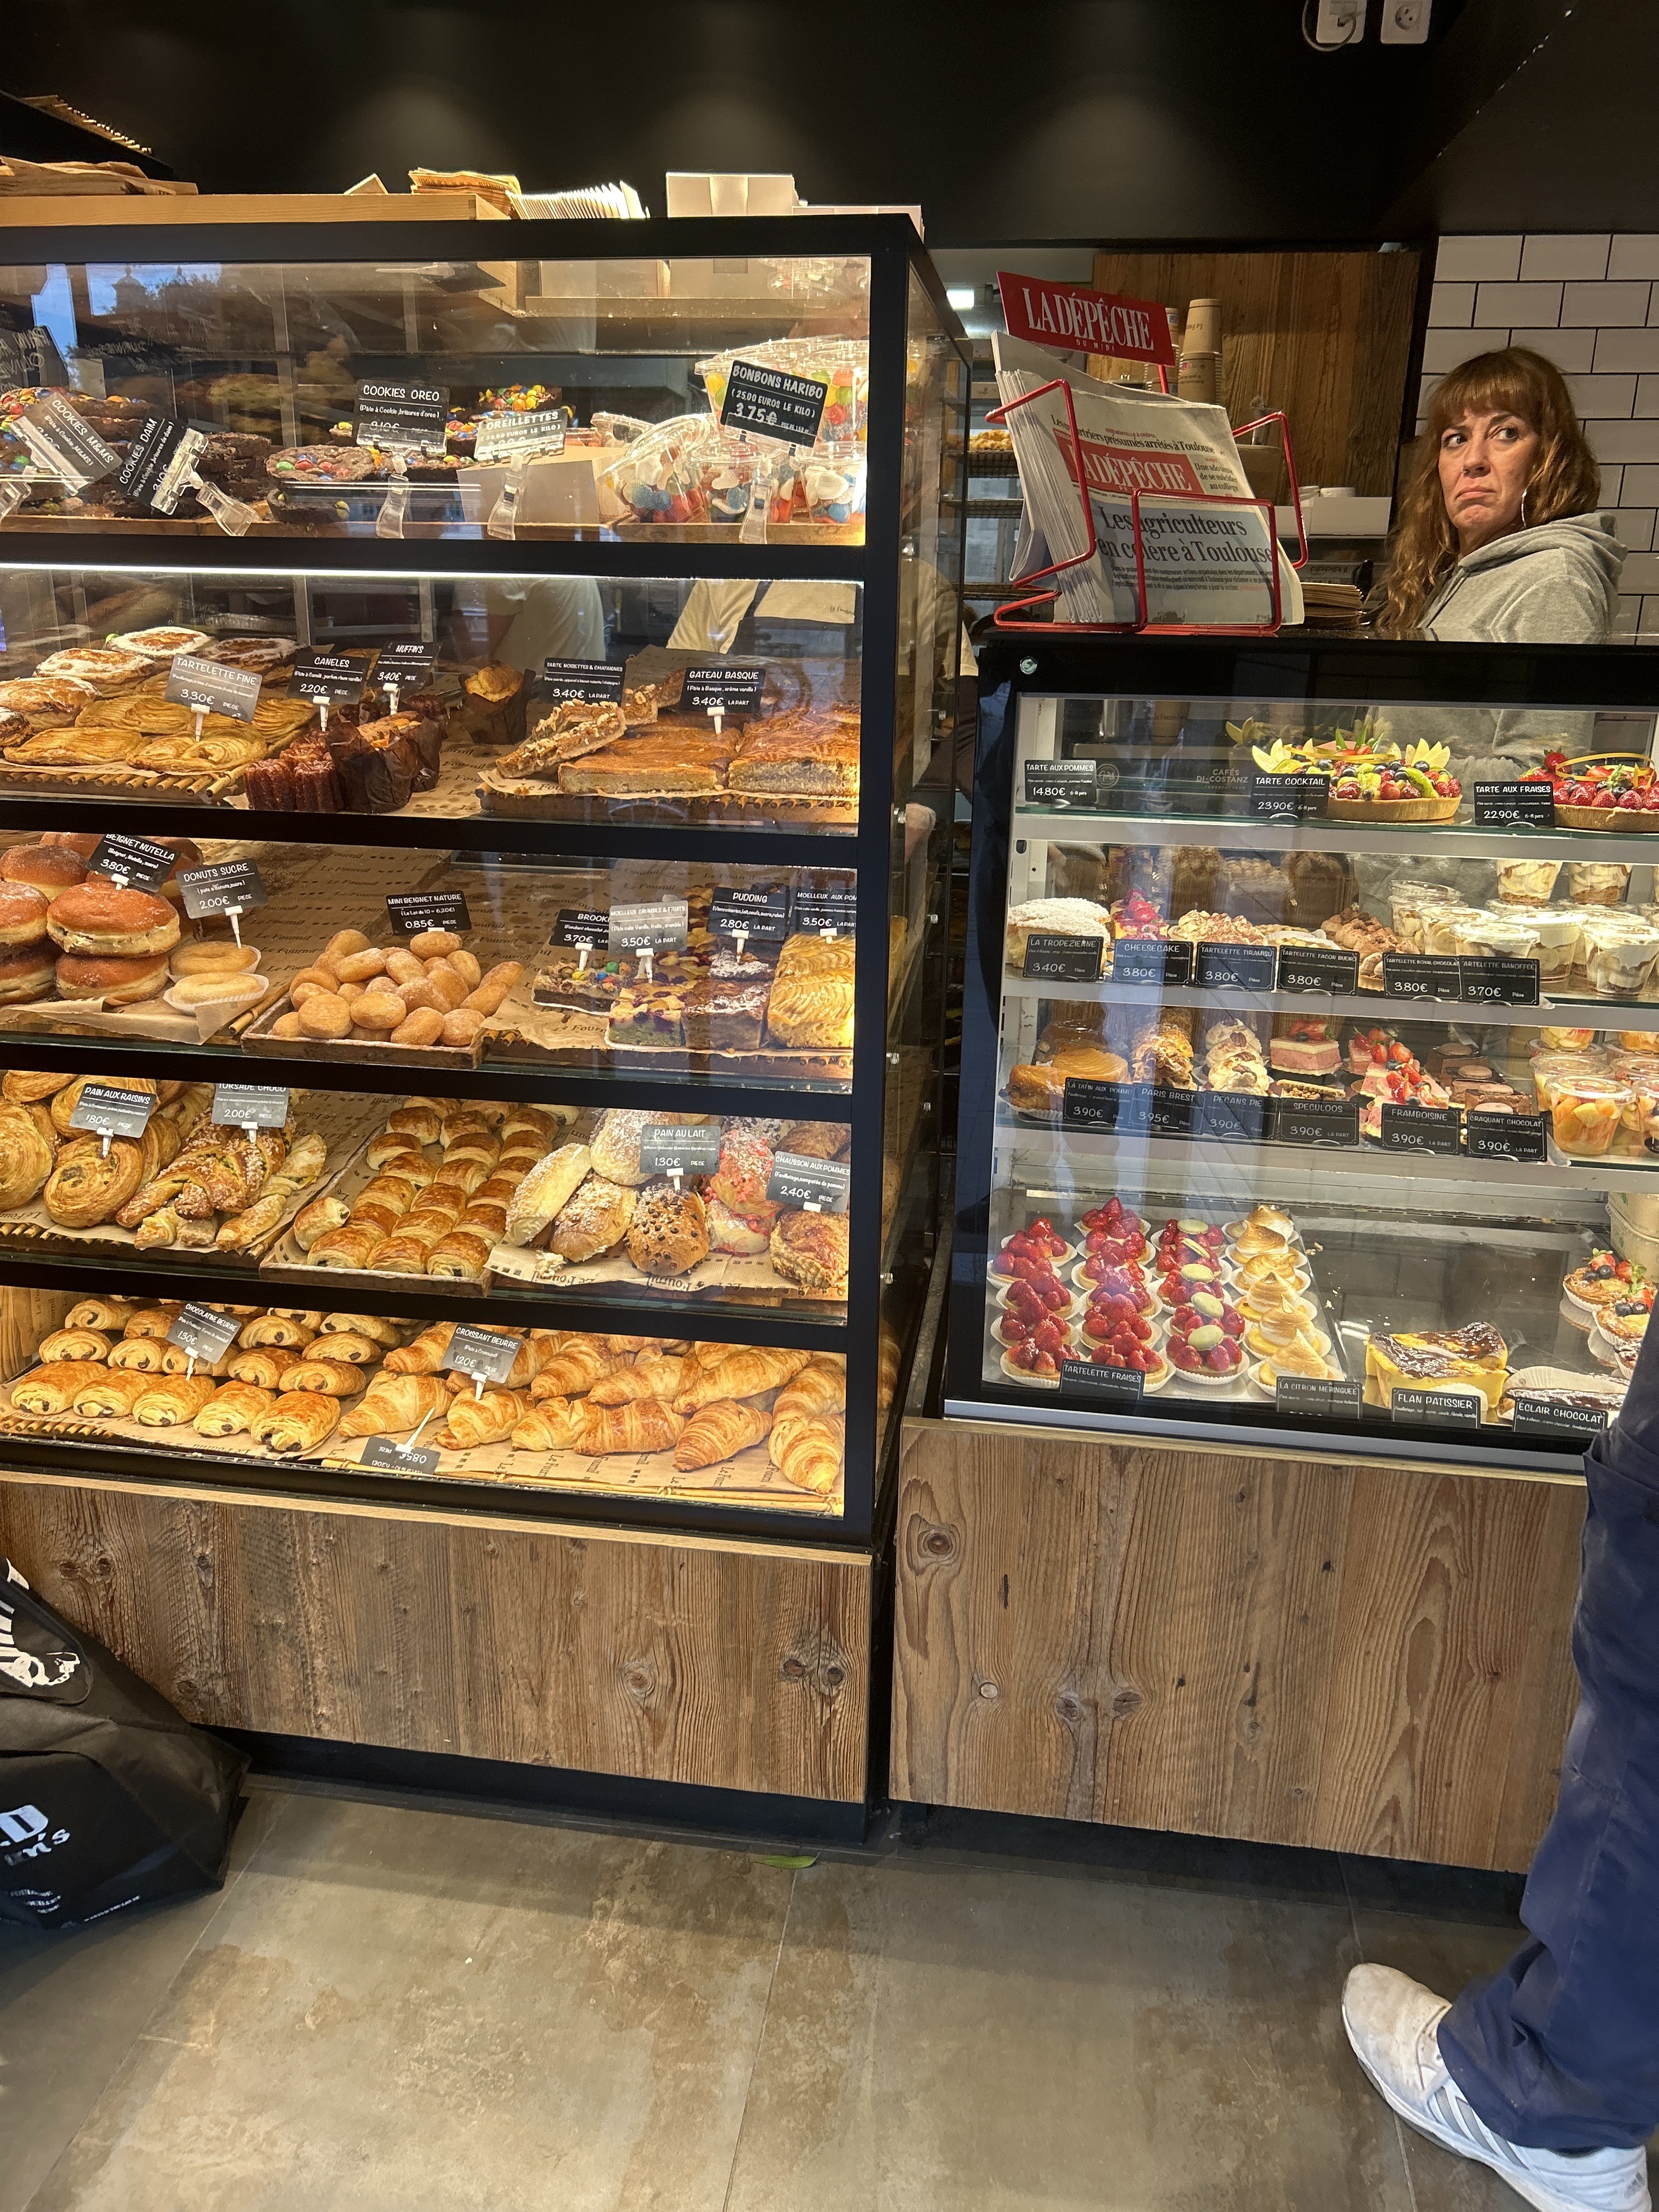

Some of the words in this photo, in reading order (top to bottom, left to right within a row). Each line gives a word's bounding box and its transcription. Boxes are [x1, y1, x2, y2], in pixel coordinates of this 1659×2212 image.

[1053, 291, 1154, 351] DÉPÊCHE
[1076, 338, 1087, 347] DU
[1093, 342, 1115, 352] MIDI
[732, 365, 781, 389] BONBONS
[783, 379, 823, 399] HARIBO
[363, 385, 406, 399] COOKIES
[410, 390, 439, 402] OREO
[758, 395, 781, 409] EUROS
[783, 402, 791, 411] LE
[794, 405, 811, 417] KILO
[486, 411, 558, 431] OREILLETTES
[51, 399, 88, 437] COOKIES
[86, 436, 114, 465] M&MS
[1063, 422, 1104, 442] mrtriers
[1104, 433, 1144, 448] présumés
[1144, 438, 1173, 450] arrêtés
[1178, 441, 1215, 453] Toulouse
[119, 444, 144, 485] COOKIES
[140, 417, 157, 443] DAIM
[1091, 452, 1193, 491] DÉPÊCHE
[1098, 505, 1133, 531] Les
[1097, 538, 1122, 558] en
[1179, 538, 1195, 561] à
[1190, 540, 1273, 563] Toulouse
[314, 657, 350, 668] CANELES
[176, 657, 235, 680] TARTELETTE
[236, 673, 257, 686] FINE
[689, 671, 723, 680] GATEAU
[725, 671, 759, 680] BASQUE
[1026, 764, 1048, 772] TARTE
[1049, 764, 1064, 772] AUX
[1064, 764, 1094, 772] POMMES
[1212, 768, 1240, 776] CAFÉS
[1255, 777, 1282, 786] TARTE
[1284, 777, 1326, 786] COCKTAIL
[1520, 785, 1551, 793] FRAISES
[140, 843, 176, 861] NUTELLA
[183, 868, 218, 883] DONUTS
[220, 862, 249, 876] SUCRE
[388, 896, 403, 905] MINI
[404, 895, 432, 905] BEIGNET
[434, 894, 462, 903] NATURE
[732, 892, 768, 904] PUDDING
[797, 891, 828, 900] MOELLEUX
[611, 909, 637, 917] MOELLEUX
[1043, 939, 1096, 949] TROPEZIENNE
[1124, 944, 1180, 953] CHEESECAKE
[1201, 946, 1240, 956] TARTELETTE
[1243, 949, 1273, 957] TIRAMISU
[1282, 949, 1316, 958] TARTELETTE
[1463, 961, 1500, 970] ARTELETTE
[1502, 962, 1536, 970] BANOFFEE
[85, 1086, 104, 1097] PAIN
[104, 1089, 120, 1099] AUX
[120, 1091, 151, 1105] RAISINS
[1142, 1088, 1166, 1099] PARIS
[1169, 1092, 1196, 1103] BREST
[1213, 1096, 1246, 1106] PECANS
[1249, 1098, 1263, 1108] PIE
[1293, 1102, 1343, 1113] SPECULOOS
[1391, 1108, 1448, 1121] FRAMBOISINE
[1469, 1115, 1504, 1125] CRAQUANT
[1506, 1118, 1542, 1128] CHOCOLAT
[653, 1128, 674, 1139] PAIN
[675, 1129, 686, 1137] AU
[687, 1129, 706, 1138] LAIT
[775, 1155, 809, 1169] CHAUSSON
[809, 1161, 822, 1171] AUX
[822, 1164, 850, 1176] POMMES
[216, 1318, 238, 1332] BEURRE
[455, 1326, 492, 1345] CROISSANT
[491, 1336, 519, 1350] BEURRE
[1064, 1364, 1109, 1379] TARTELETTE
[1111, 1372, 1141, 1384] FRAISES
[1291, 1383, 1317, 1392] CITRON
[1318, 1385, 1357, 1396] MERINGUEE
[1397, 1393, 1422, 1404] FLAN
[1425, 1396, 1473, 1409] PATISSIER
[1518, 1402, 1550, 1415] ECLAIR
[1553, 1408, 1603, 1425] CHOCOLAT
